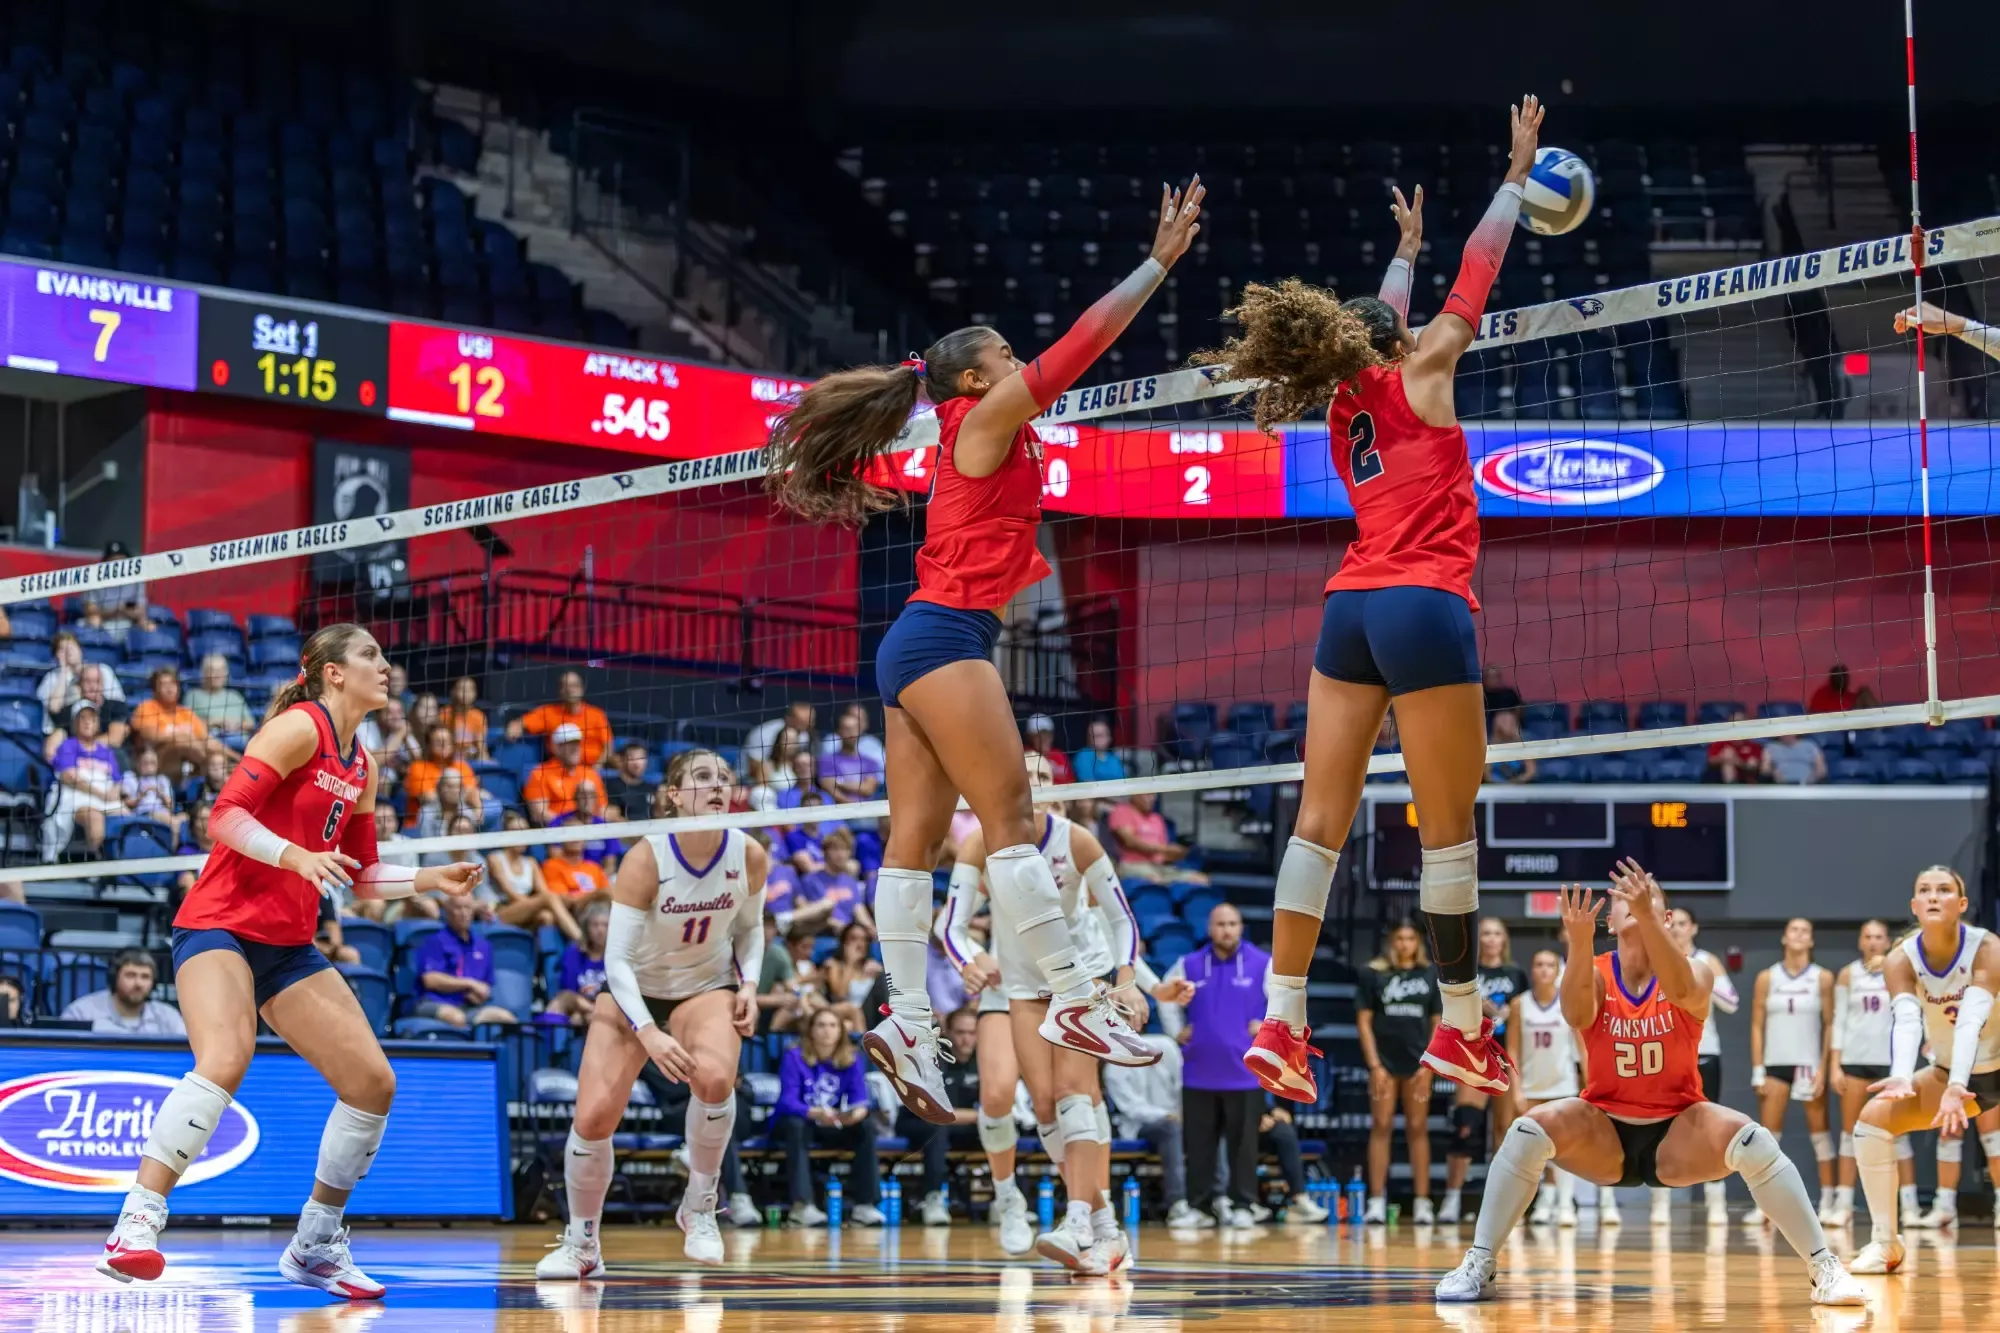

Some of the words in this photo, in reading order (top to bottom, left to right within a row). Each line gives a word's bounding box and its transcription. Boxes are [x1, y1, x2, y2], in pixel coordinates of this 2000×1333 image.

[1657, 252, 1822, 308] SCREAMING
[1838, 229, 1946, 275] EAGLS
[36, 269, 173, 312] EVANSVILLE
[89, 310, 122, 362] 7
[253, 314, 299, 355] Set
[302, 321, 319, 358] 1
[457, 332, 494, 359] USI
[211, 359, 230, 386] 0
[258, 352, 338, 402] 1:15
[449, 362, 504, 417] 12
[583, 352, 659, 385] ATTACK
[660, 364, 680, 389] %
[358, 380, 377, 407] 0
[1079, 378, 1157, 412] EAGLES
[591, 393, 671, 442] .545
[1348, 410, 1385, 488] 2
[424, 493, 514, 526] SCREAMING
[522, 482, 580, 509] EAGLES
[1183, 465, 1212, 505] 2
[210, 534, 288, 563] SCREAMING
[296, 524, 348, 548] EAGLES
[20, 567, 90, 594] SCREAMING
[97, 559, 143, 582] EAGLES
[322, 799, 345, 842] 6
[1651, 802, 1688, 828] UE
[1505, 854, 1559, 873] PERIOD
[660, 892, 735, 914] Evansville
[682, 916, 712, 944] 11
[1534, 1031, 1552, 1049] 10
[1614, 1040, 1665, 1078] 20
[37, 1089, 154, 1139] Herit
[47, 1140, 144, 1157] PETROLEU
